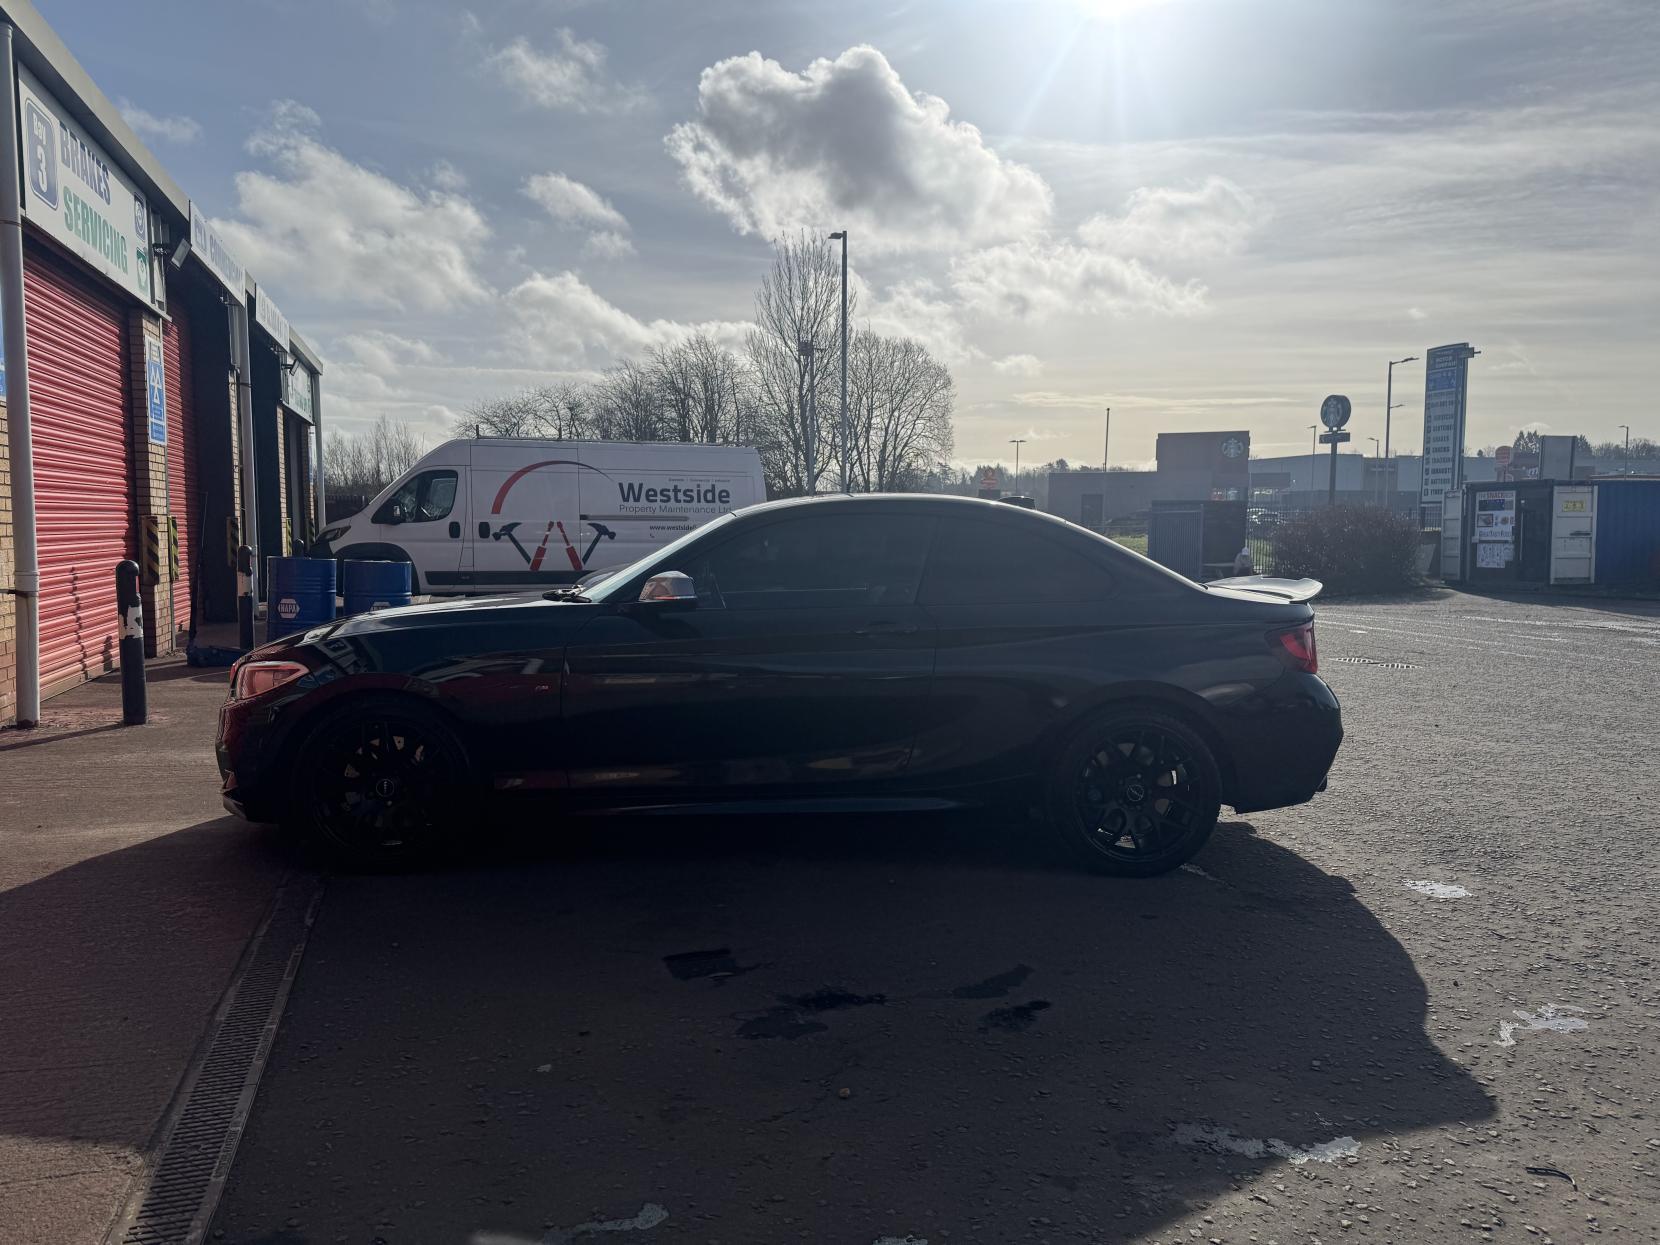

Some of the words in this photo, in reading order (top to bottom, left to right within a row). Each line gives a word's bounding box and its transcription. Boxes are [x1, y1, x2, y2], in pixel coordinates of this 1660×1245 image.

[37, 146, 48, 193] 3
[59, 120, 111, 207] BRAKES
[63, 185, 129, 274] SERVICING
[618, 482, 731, 504] Westside
[619, 504, 656, 515] Property
[659, 505, 716, 514] Maintenance
[718, 505, 733, 514] Ltd
